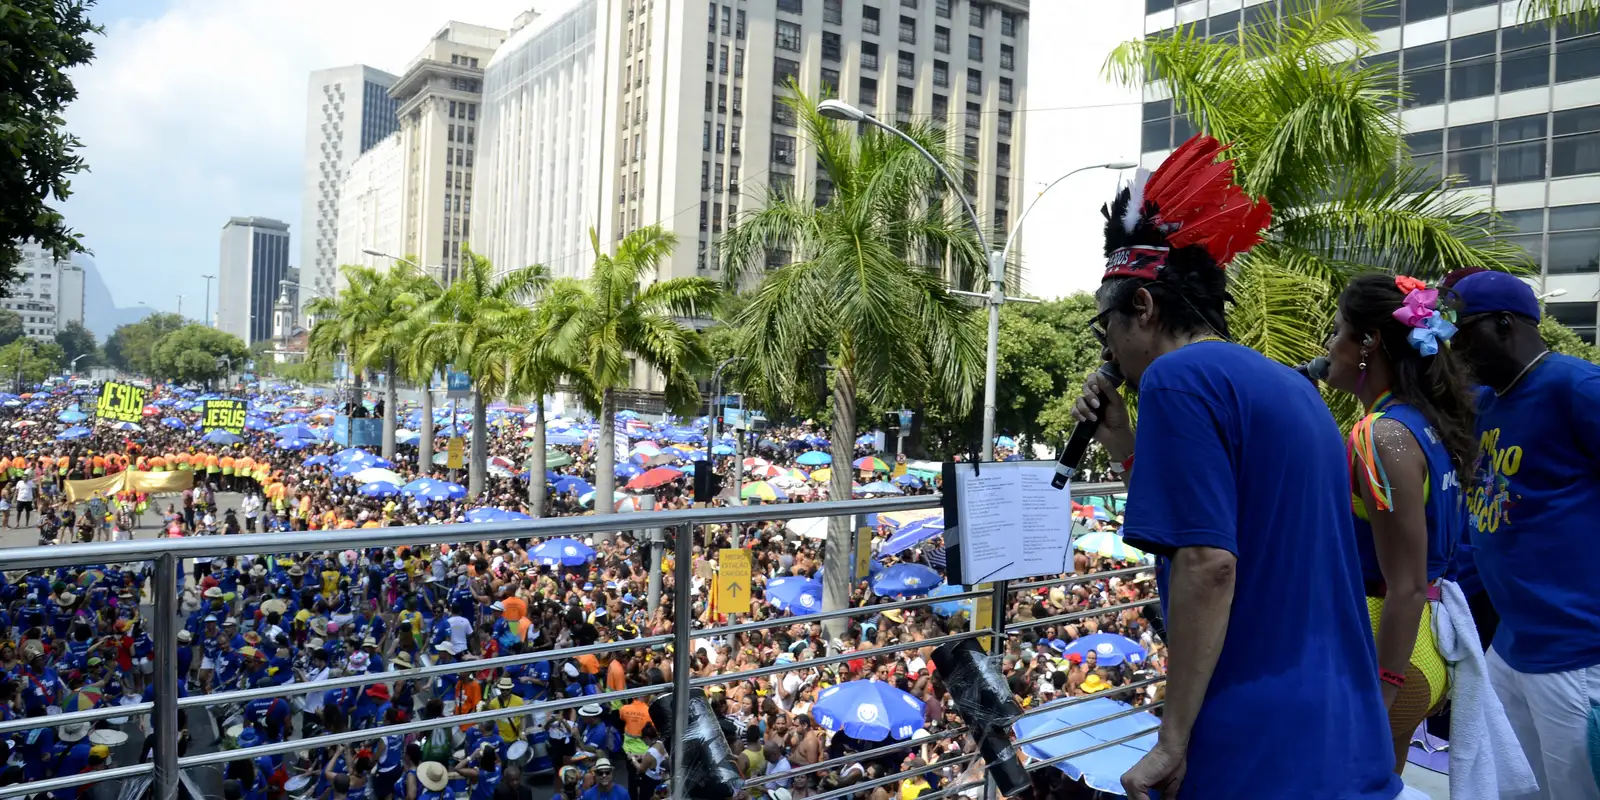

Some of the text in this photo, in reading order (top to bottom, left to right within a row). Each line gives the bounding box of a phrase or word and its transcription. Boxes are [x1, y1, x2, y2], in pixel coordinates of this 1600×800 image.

[97, 382, 144, 415] JESUS
[207, 400, 234, 409] BUSQUE
[203, 409, 246, 427] JESUS
